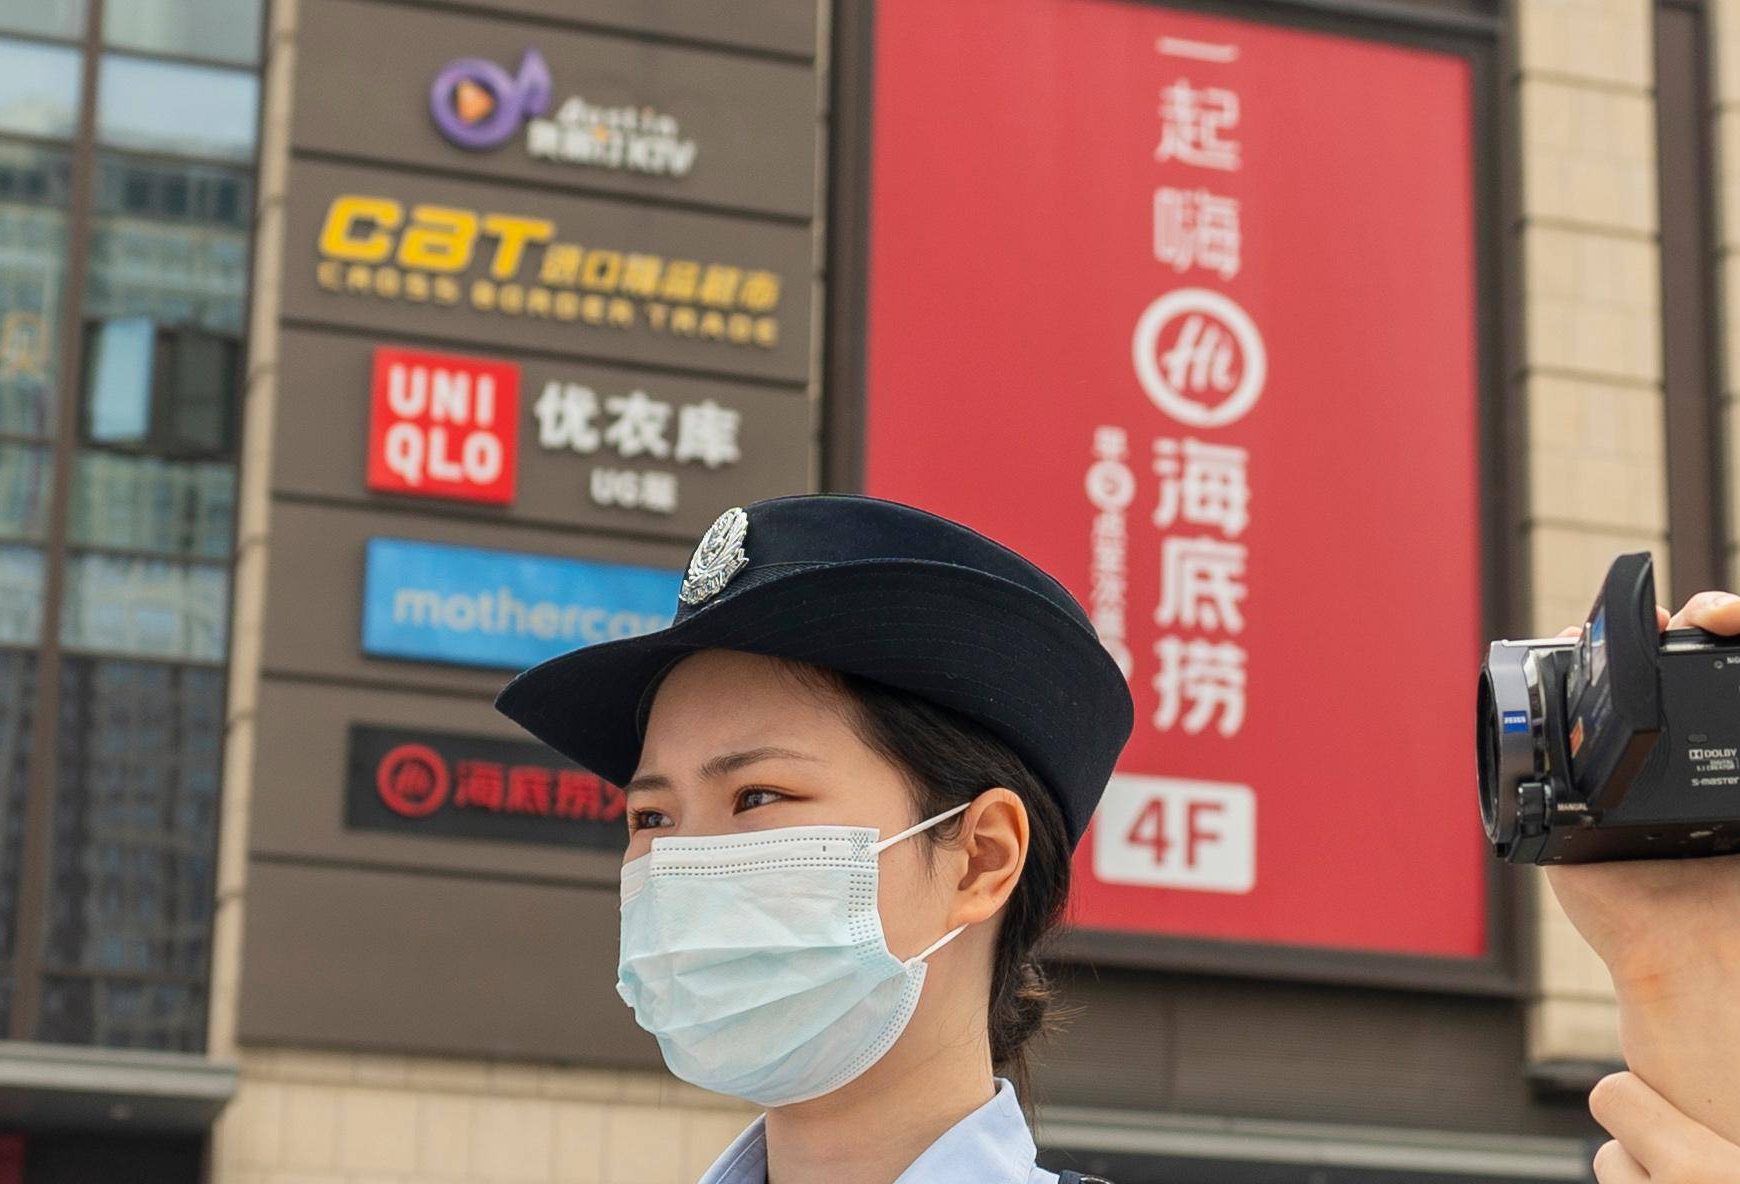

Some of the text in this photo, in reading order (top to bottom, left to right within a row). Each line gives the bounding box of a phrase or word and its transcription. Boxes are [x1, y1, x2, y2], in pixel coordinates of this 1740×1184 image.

[1153, 37, 1242, 280] 一起嗨
[317, 261, 461, 304] CROSS
[645, 301, 779, 348] TRADE
[388, 364, 497, 424] UNI
[533, 380, 741, 468] 优衣库
[385, 421, 503, 487] QLO
[1152, 437, 1250, 738] 海底捞
[1704, 748, 1737, 758] DOLBY
[1126, 796, 1223, 868] 4F
